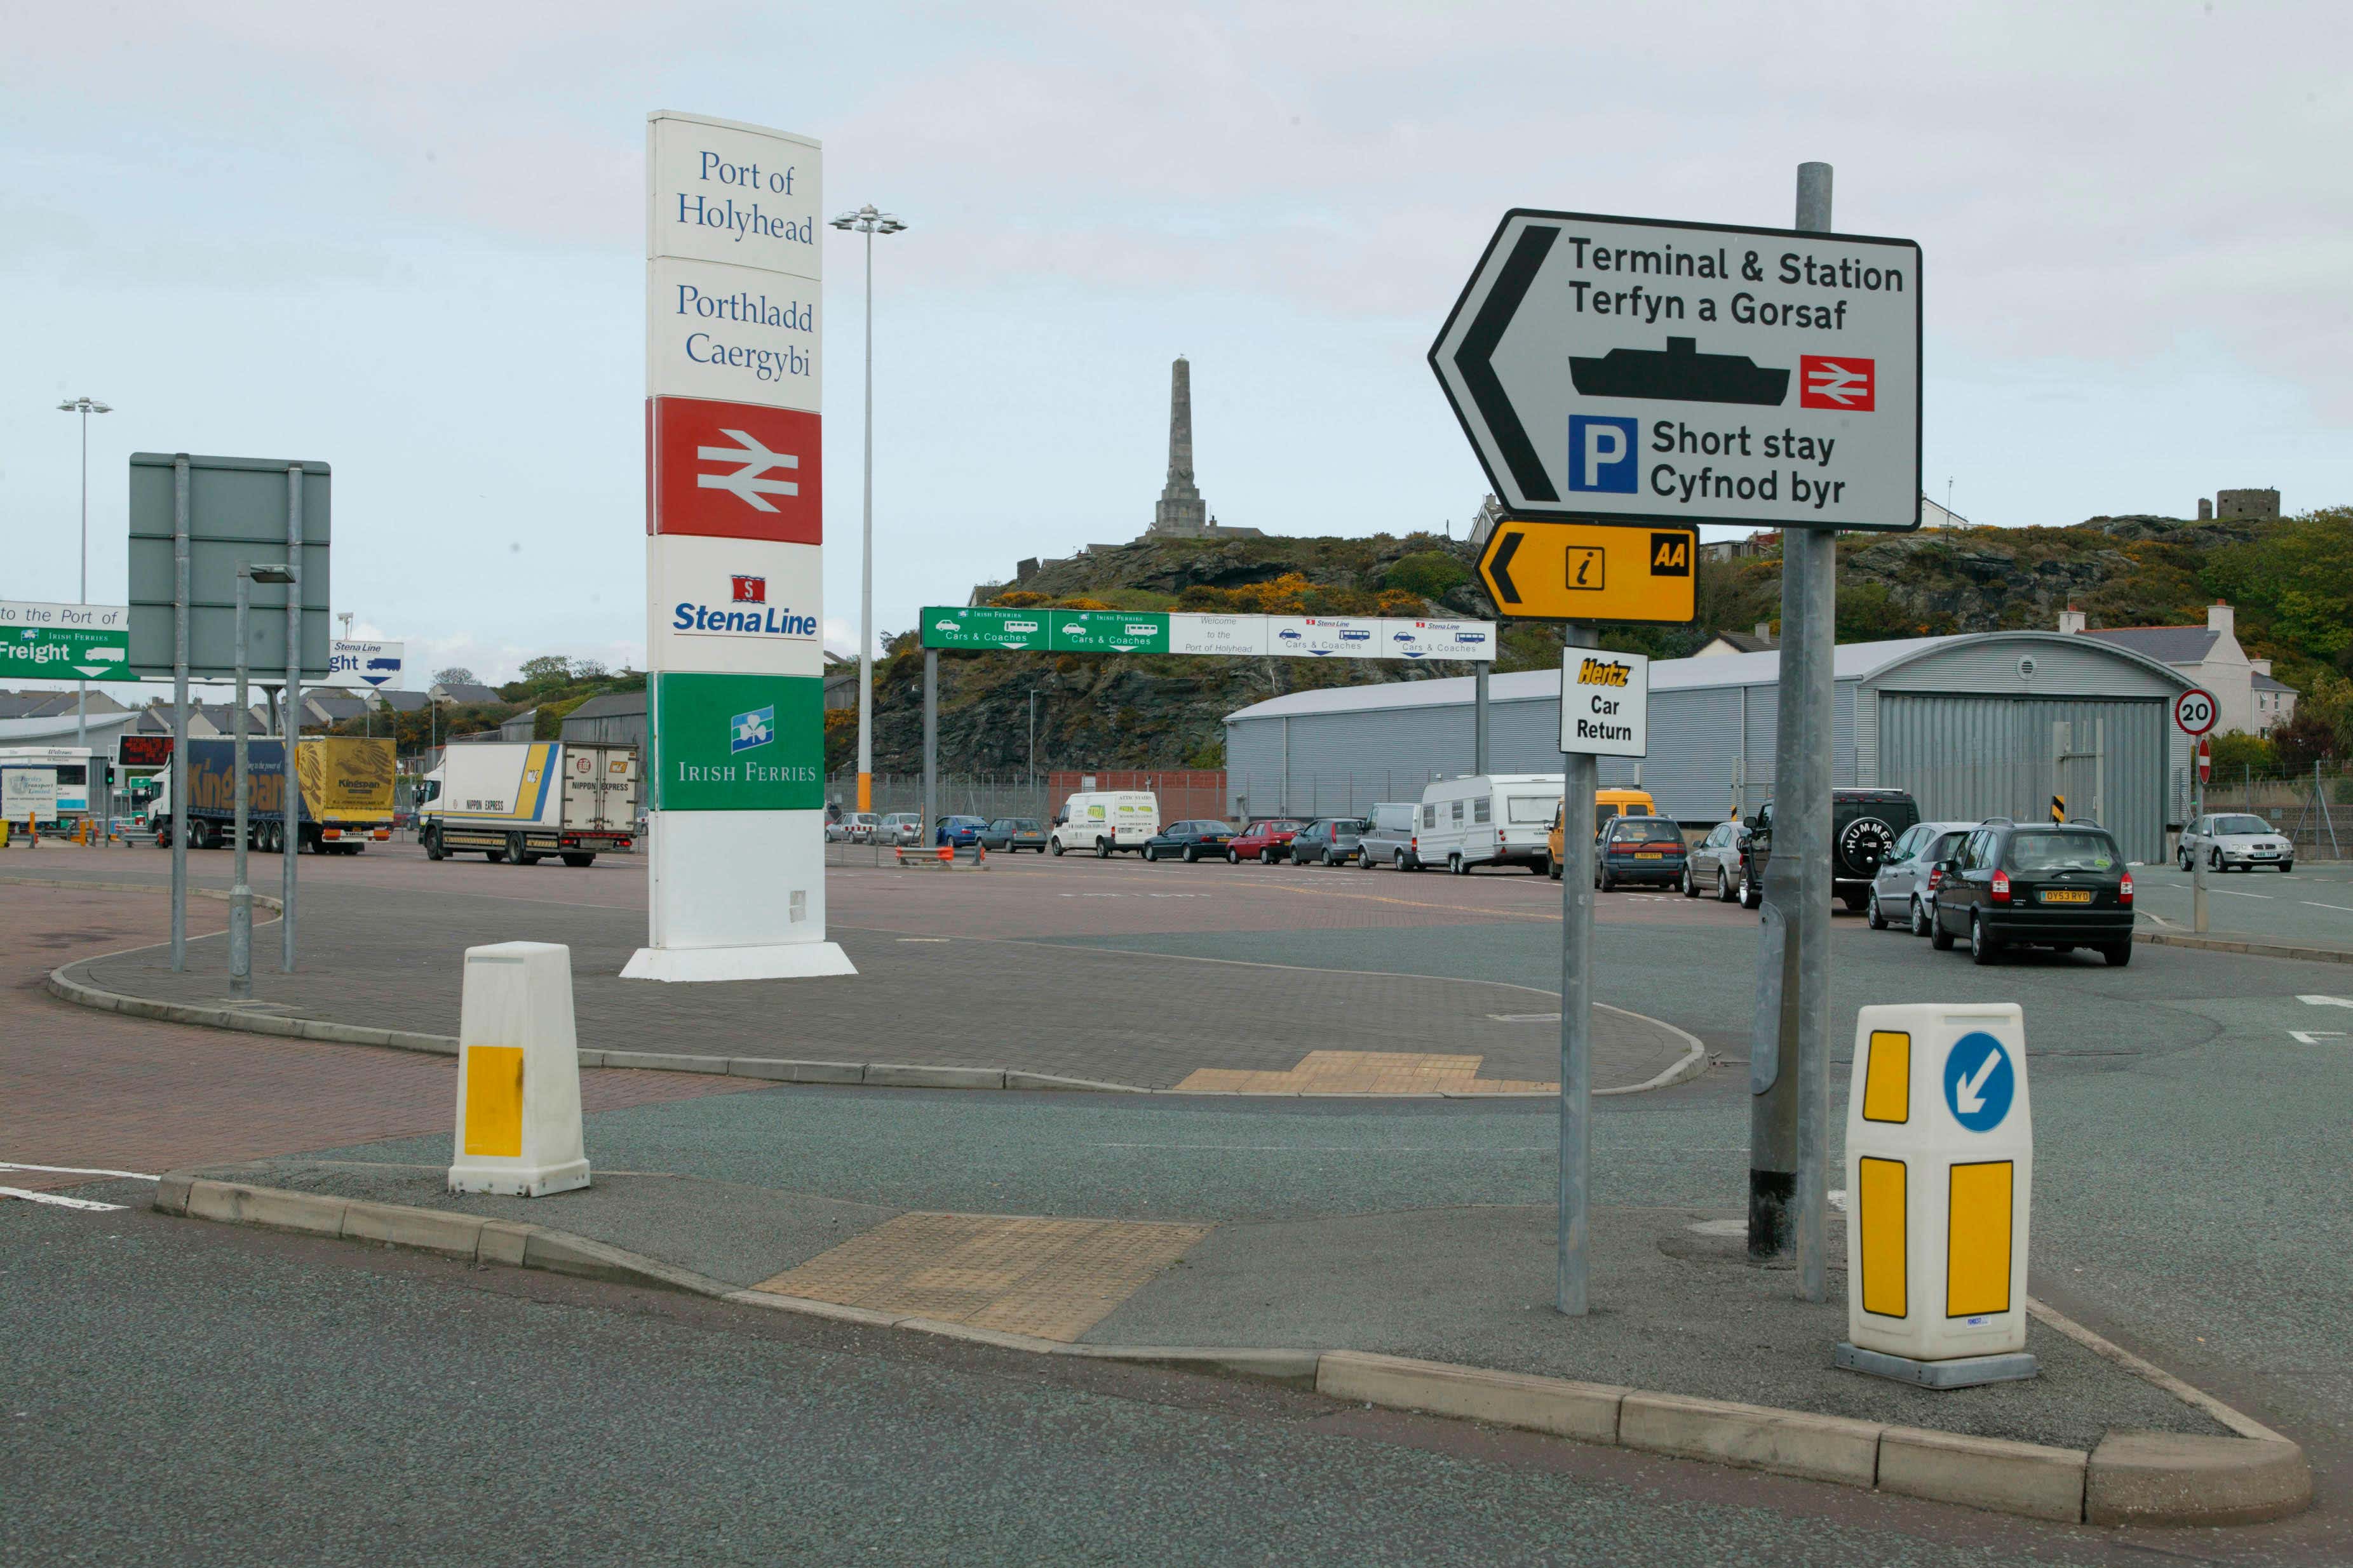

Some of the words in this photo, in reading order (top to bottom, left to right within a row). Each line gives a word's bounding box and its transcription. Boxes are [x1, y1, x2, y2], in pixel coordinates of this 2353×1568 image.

[699, 150, 761, 189] Port
[769, 166, 795, 196] of
[677, 193, 814, 246] Holyhead
[1568, 236, 1729, 279] Terminal
[1741, 250, 1763, 281] &
[1778, 253, 1903, 292] Station
[677, 284, 814, 333] Porthladd
[1568, 280, 1685, 324] Terfyn
[1698, 298, 1717, 322] a
[1731, 291, 1847, 330] Gorsaf
[685, 333, 811, 382] Caergybi
[1652, 420, 1751, 457] Short
[1763, 427, 1835, 467] stay
[1584, 424, 1627, 486] P
[1651, 464, 1777, 503] Cyfnod
[1792, 471, 1845, 509] byr
[1653, 542, 1685, 567] AA
[0, 606, 16, 620] to
[26, 608, 51, 622] the
[61, 609, 93, 624] Port
[102, 611, 118, 625] of
[673, 603, 760, 633] Stena
[765, 608, 817, 636] Line
[1200, 615, 1237, 625] Welcome
[49, 632, 72, 640] IRISH
[74, 633, 109, 641] FERRIES
[945, 631, 968, 640] Cars
[973, 633, 980, 641] &
[984, 633, 1027, 641] Coaches
[1072, 635, 1093, 643] Cars
[1109, 636, 1151, 645] Coaches
[1217, 631, 1230, 639] the
[1286, 640, 1307, 648] Cars
[1321, 641, 1361, 649] Coaches
[0, 641, 70, 664] Freight
[334, 641, 361, 652] Stena
[362, 643, 381, 652] Line
[1185, 643, 1202, 652] Port
[1216, 644, 1252, 653] Holyhead
[1402, 643, 1423, 651] Cars
[1437, 643, 1476, 652] Coaches
[1577, 657, 1631, 687] Hertz
[1591, 695, 1619, 715] Car
[2182, 703, 2209, 721] 20
[1577, 718, 1631, 741] Return
[678, 761, 736, 782] IRISH
[745, 761, 816, 782] FERRIES
[338, 779, 380, 789] Kingspan
[572, 782, 596, 790] NIPPON
[600, 782, 628, 791] EXPRESS
[466, 800, 482, 810] NIPPON
[485, 800, 504, 810] EXPRESS
[1847, 823, 1892, 849] HUMMER
[2047, 892, 2070, 900] OY53
[2072, 892, 2089, 901] RYD
